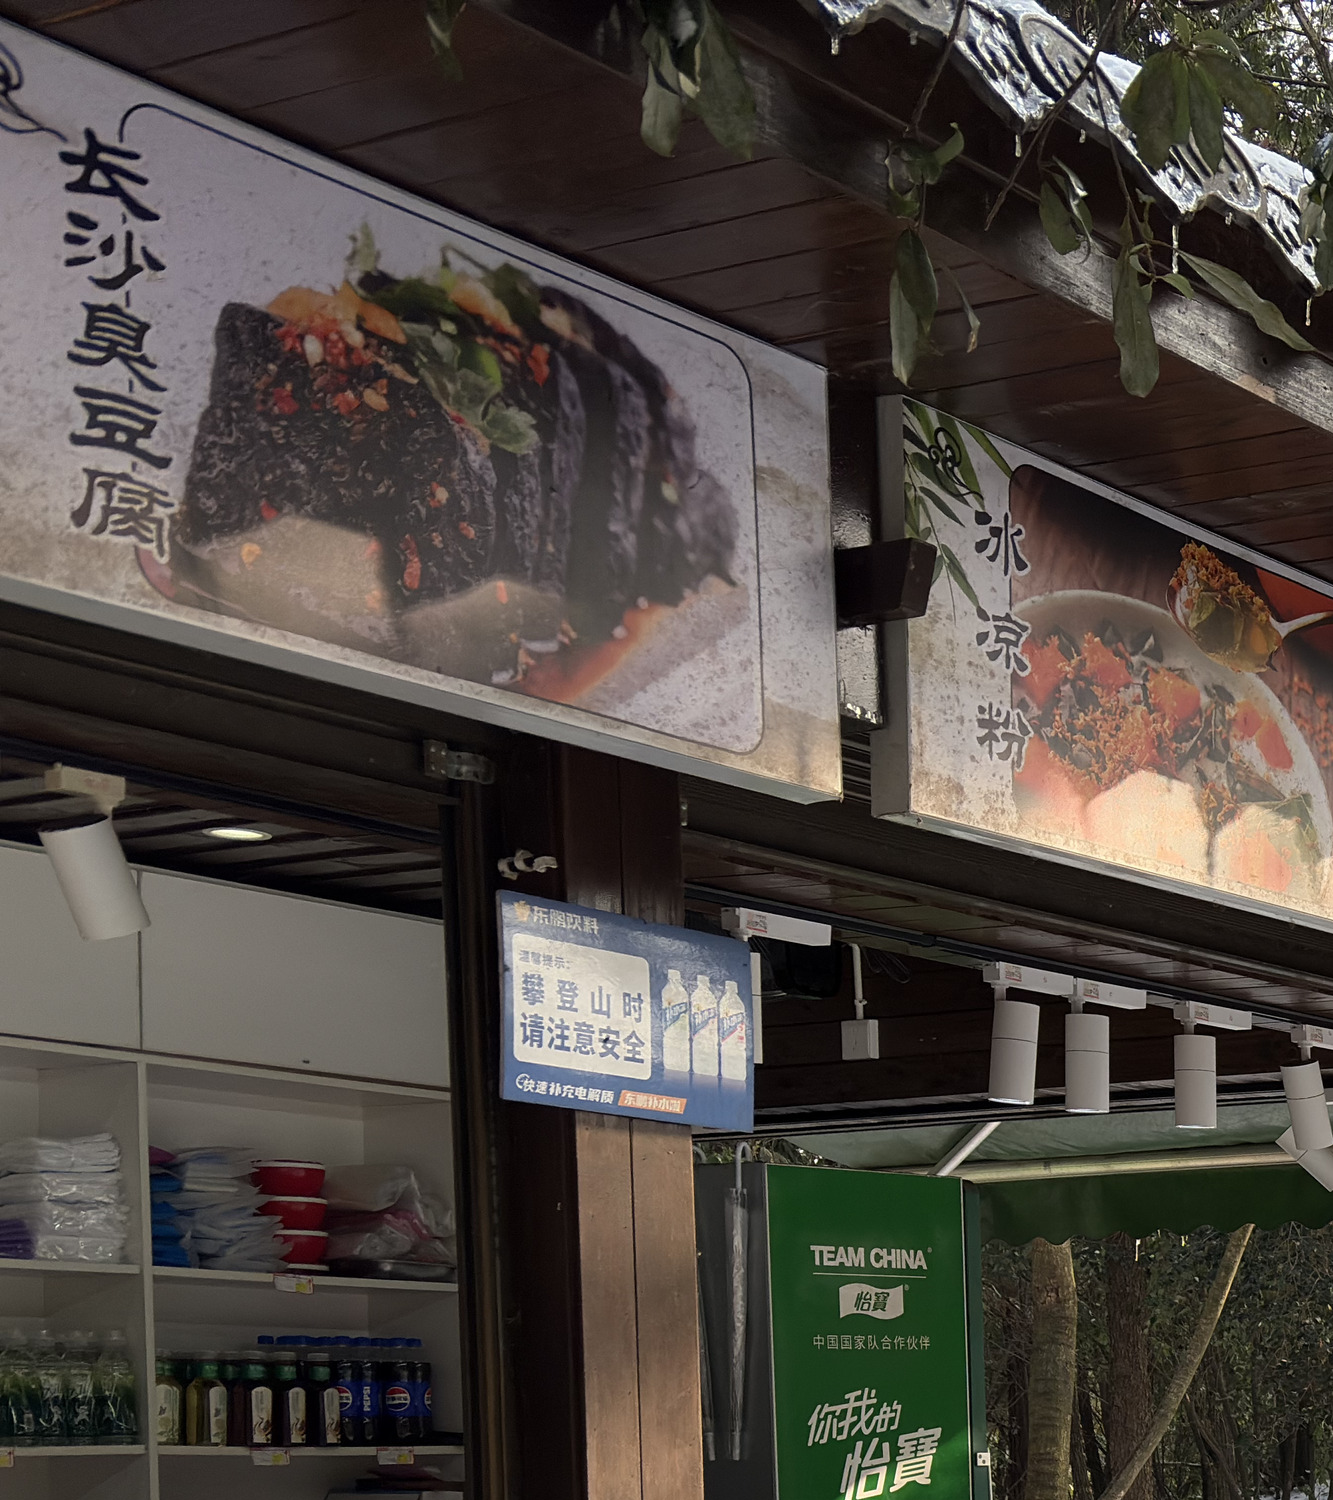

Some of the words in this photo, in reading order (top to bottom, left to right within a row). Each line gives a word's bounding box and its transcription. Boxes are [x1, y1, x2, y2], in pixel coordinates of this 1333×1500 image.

[59, 129, 172, 562] 长沙臭豆腐
[975, 511, 1031, 771] 冰凉粉
[531, 905, 599, 935] 东鹏饮料
[521, 972, 643, 1024] 攀登山时
[520, 1013, 645, 1065] 请注意安全
[523, 1077, 615, 1105] 快速补充电解质
[810, 1245, 865, 1268] TEAM
[869, 1248, 927, 1270] CHINA
[813, 1334, 931, 1350] 中国国家队合作伙伴
[363, 1386, 371, 1412] PEPSI
[807, 1387, 902, 1446] 你我的
